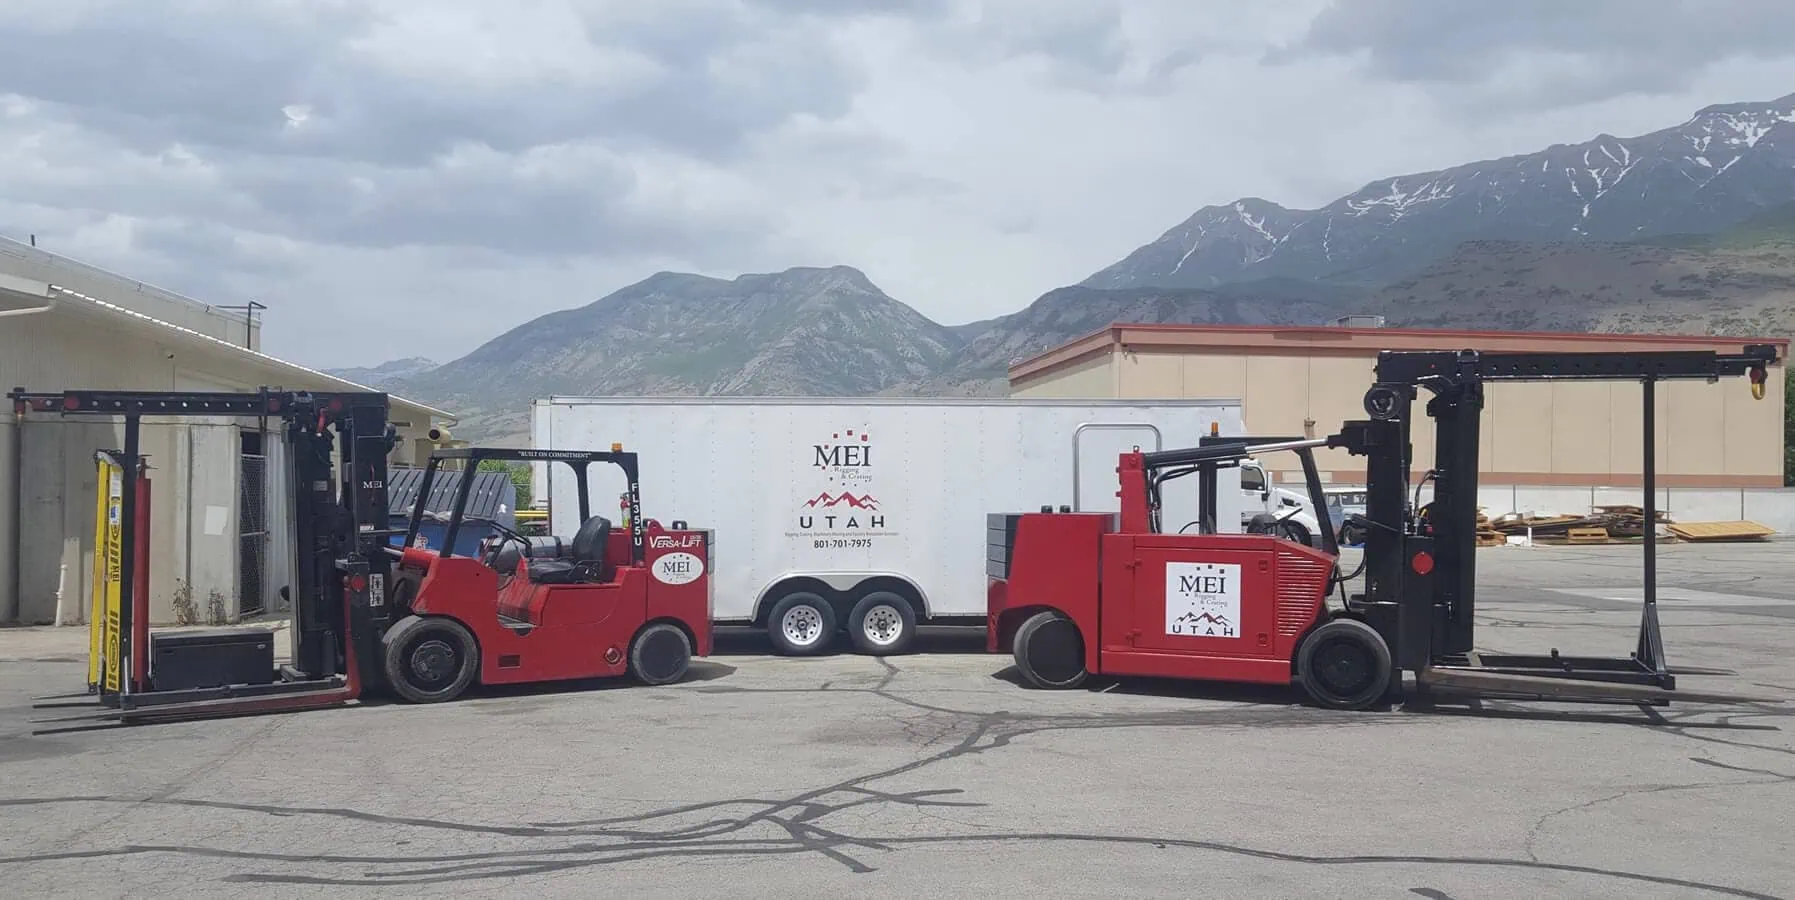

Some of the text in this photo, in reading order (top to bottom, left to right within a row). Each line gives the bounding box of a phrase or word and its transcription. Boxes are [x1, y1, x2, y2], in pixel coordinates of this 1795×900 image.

[813, 445, 872, 467] MEI
[834, 466, 859, 474] Rigging
[848, 473, 872, 482] Crating
[363, 481, 383, 489] MEI
[631, 483, 642, 546] FL355U
[800, 514, 884, 529] UTAH
[814, 539, 872, 549] 801-701-7975
[663, 561, 690, 573] MEI
[1179, 575, 1226, 594] MEI
[1206, 599, 1228, 607] Crating
[1172, 623, 1233, 636] UTAH
